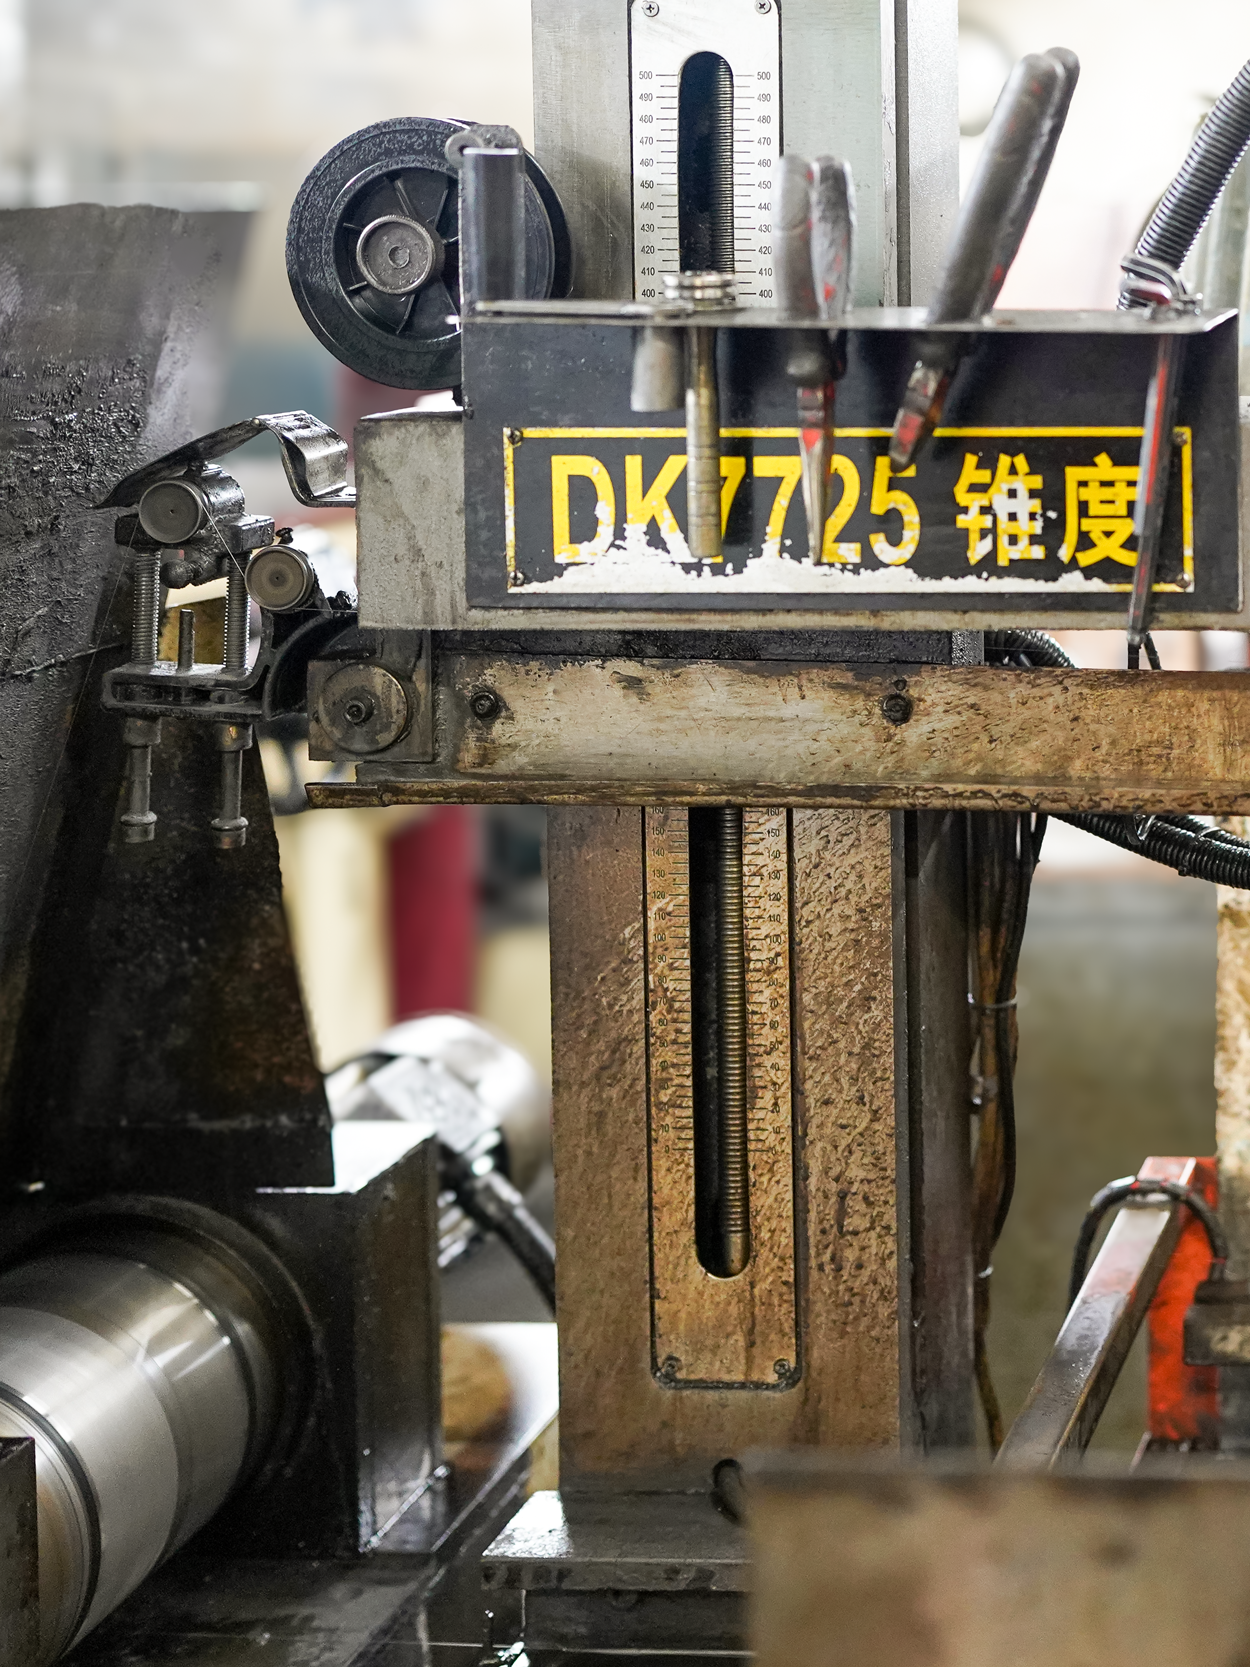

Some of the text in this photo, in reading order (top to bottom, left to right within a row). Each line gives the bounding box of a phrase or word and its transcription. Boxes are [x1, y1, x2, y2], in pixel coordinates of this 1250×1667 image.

[639, 71, 653, 80] 500
[757, 72, 771, 80] 500
[639, 93, 653, 101] 490
[757, 93, 771, 102] 490
[639, 115, 653, 123] 480
[757, 115, 771, 124] 480
[639, 136, 653, 145] 470
[757, 137, 771, 146] 470
[640, 158, 654, 167] 460
[757, 159, 772, 167] 460
[640, 180, 654, 189] 450
[757, 181, 772, 189] 450
[640, 202, 654, 211] 440
[758, 202, 772, 211] 440
[640, 224, 654, 233] 430
[758, 224, 772, 233] 430
[640, 245, 655, 255] 420
[758, 246, 772, 255] 420
[641, 267, 655, 276] 410
[758, 267, 773, 276] 410
[641, 289, 655, 298] 400
[758, 289, 773, 298] 400
[953, 452, 1142, 567] 锥度
[766, 807, 779, 816] 160
[652, 827, 664, 835] 150
[766, 829, 780, 837] 150
[652, 848, 664, 856] 140
[767, 850, 780, 859] 140
[652, 869, 665, 878] 130
[767, 871, 780, 880] 130
[652, 890, 666, 899] 120
[768, 893, 781, 901] 120
[653, 912, 666, 920] 110
[768, 914, 781, 923] 110
[653, 933, 666, 942] 100
[769, 935, 781, 944] 100
[657, 954, 666, 963] 90
[770, 1062, 779, 1071] 40
[772, 1126, 780, 1134] 10
